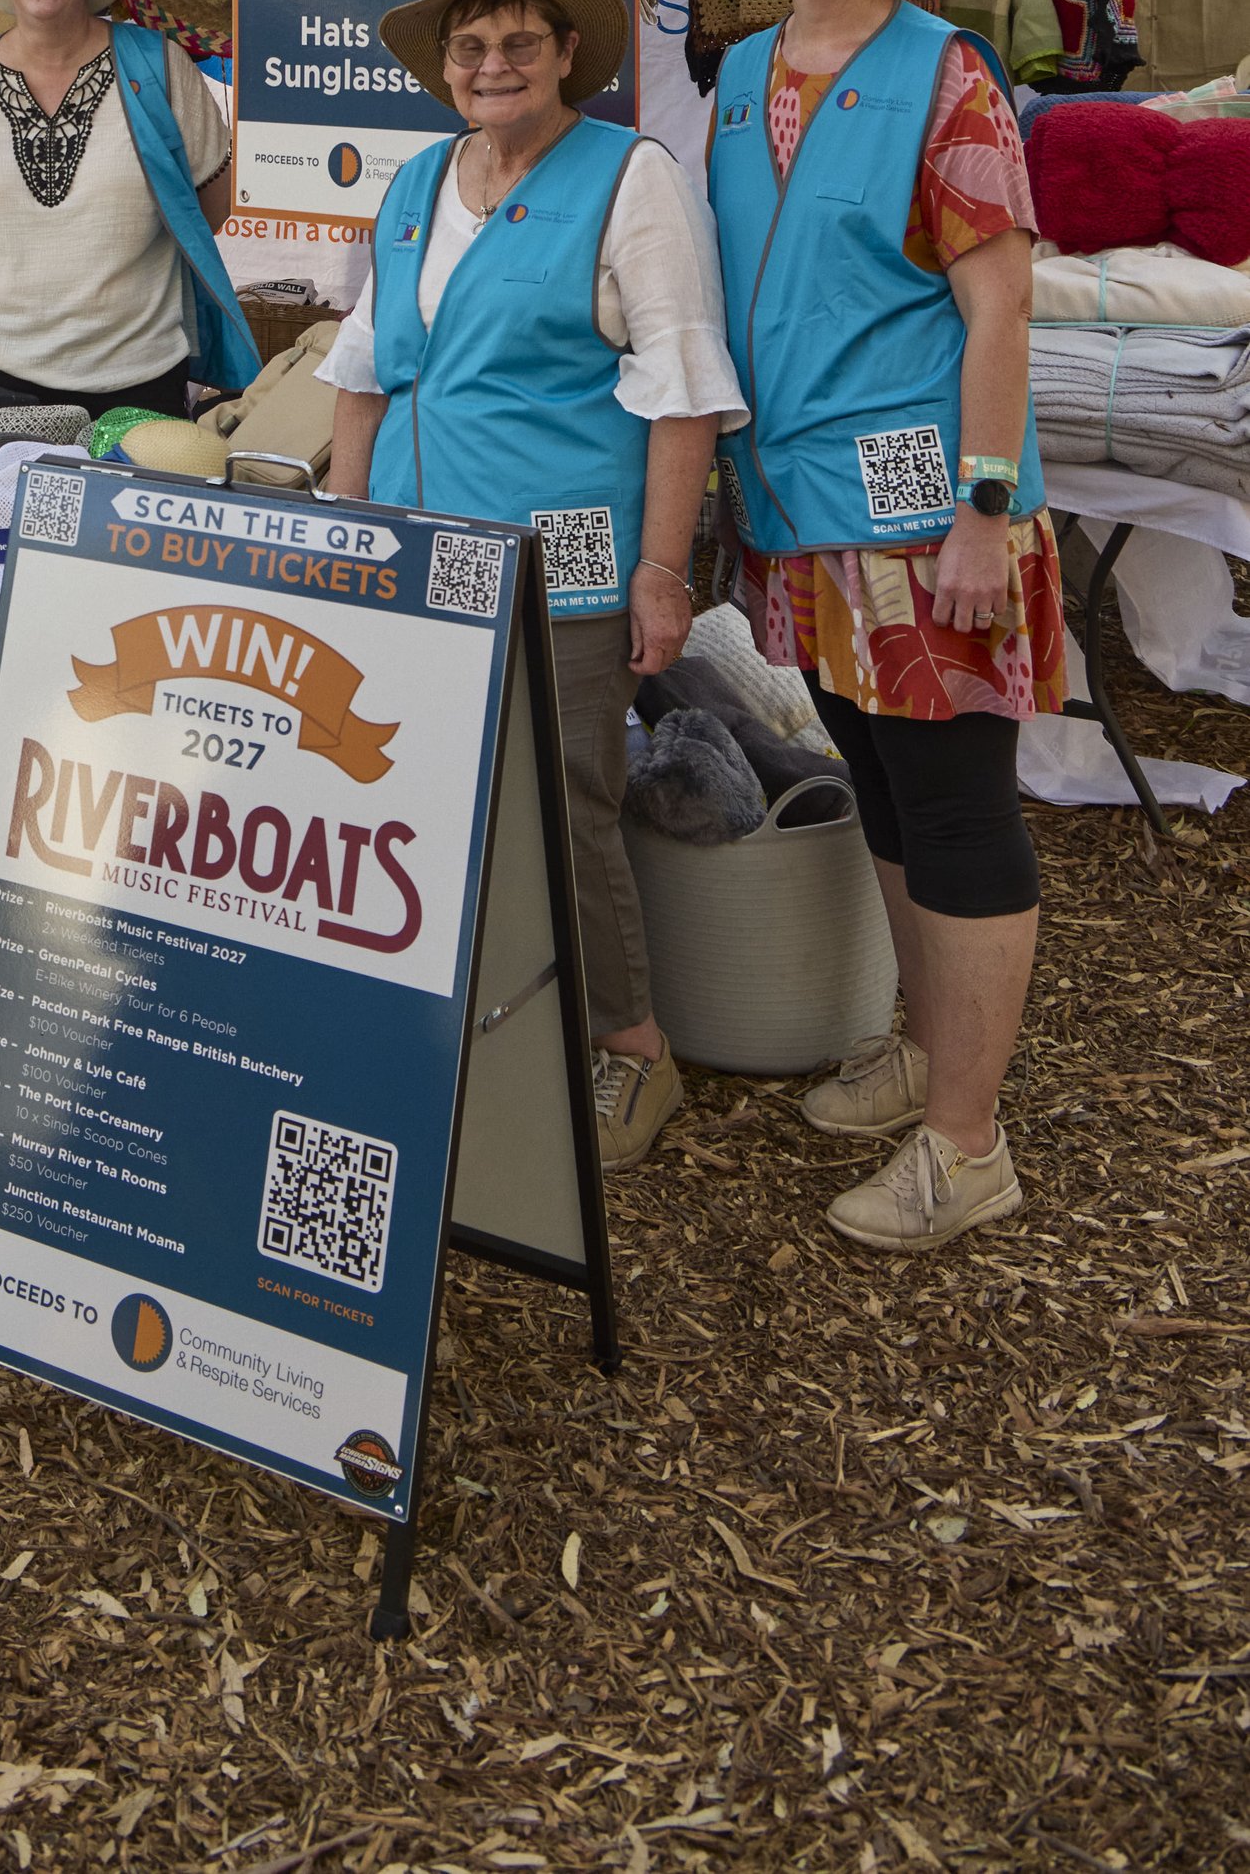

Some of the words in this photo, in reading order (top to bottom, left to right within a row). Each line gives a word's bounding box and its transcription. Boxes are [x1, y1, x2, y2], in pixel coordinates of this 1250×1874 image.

[301, 15, 370, 48] Hats
[264, 56, 430, 96] Sunglasse
[254, 153, 305, 167] PROCEEDS
[306, 157, 320, 168] TO
[365, 168, 371, 179] &
[277, 283, 303, 293] WALL
[134, 494, 226, 531] SCAN
[243, 510, 309, 544] THE
[326, 524, 376, 555] QR
[873, 523, 901, 534] SCAN
[903, 521, 920, 531] ME
[923, 519, 936, 529] TO
[107, 522, 150, 557] TO
[162, 532, 238, 572] BUY
[244, 547, 398, 601] TICKETS
[569, 596, 584, 606] ME
[586, 595, 599, 605] TO
[601, 593, 619, 604] WIN
[156, 613, 315, 697] WIN!
[163, 692, 254, 729] TICKETS
[262, 712, 293, 736] TO
[181, 729, 266, 771] 2027
[5, 737, 423, 954] RIVERBOATS
[102, 862, 178, 900] MUSIC
[187, 887, 307, 932] FESTIVAL
[45, 901, 113, 930] Riverboats
[116, 917, 153, 941] Music
[156, 930, 208, 957] Festival
[211, 945, 247, 966] 2027
[60, 926, 117, 952] Weekend
[121, 942, 165, 967] Tickets
[38, 948, 112, 979] GreenPedal
[114, 970, 157, 993] Cycles
[35, 969, 75, 993] E-Bike
[78, 981, 122, 1006] Winery
[126, 994, 154, 1013] Tour
[158, 1003, 175, 1019] for
[179, 1010, 188, 1024] 6
[191, 1013, 237, 1038] People
[29, 1015, 59, 1035] $100
[61, 1026, 114, 1052] Voucher
[31, 995, 79, 1020] Pacdon
[81, 1009, 110, 1028] Park
[113, 1019, 143, 1038] Free
[146, 1029, 189, 1053] Range
[193, 1042, 237, 1066] British
[240, 1056, 303, 1087] Butchery
[21, 1063, 51, 1083] $100
[54, 1073, 106, 1100] Voucher
[24, 1043, 71, 1069] Johnny
[73, 1056, 83, 1071] &
[86, 1060, 113, 1082] Lyle
[116, 1069, 146, 1090] Café
[18, 1083, 42, 1102] The
[44, 1091, 72, 1112] Port
[75, 1101, 163, 1142] Ice-Creamery
[15, 1105, 29, 1120] 10
[31, 1112, 39, 1124] x
[42, 1114, 81, 1138] Single
[83, 1128, 124, 1152] Scoop
[127, 1142, 168, 1166] Cones
[8, 1153, 33, 1172] $50
[36, 1163, 88, 1191] Voucher
[11, 1132, 54, 1158] Murray
[58, 1147, 92, 1169] River
[94, 1159, 118, 1178] Tea
[121, 1168, 167, 1195] Rooms
[1, 1201, 33, 1225] $250
[36, 1214, 89, 1244] Voucher
[3, 1182, 59, 1210] Junction
[62, 1202, 132, 1237] Restaurant
[136, 1226, 185, 1255] Moama
[71, 1299, 98, 1325] TO
[256, 1277, 291, 1299] SCAN
[293, 1288, 319, 1308] FOR
[322, 1298, 375, 1327] TICKETS
[175, 1349, 188, 1369] &
[189, 1356, 250, 1395] Respite
[252, 1380, 323, 1421] Services
[179, 1327, 272, 1380] Community
[275, 1360, 325, 1400] Living
[364, 1456, 403, 1480] SIGNS
